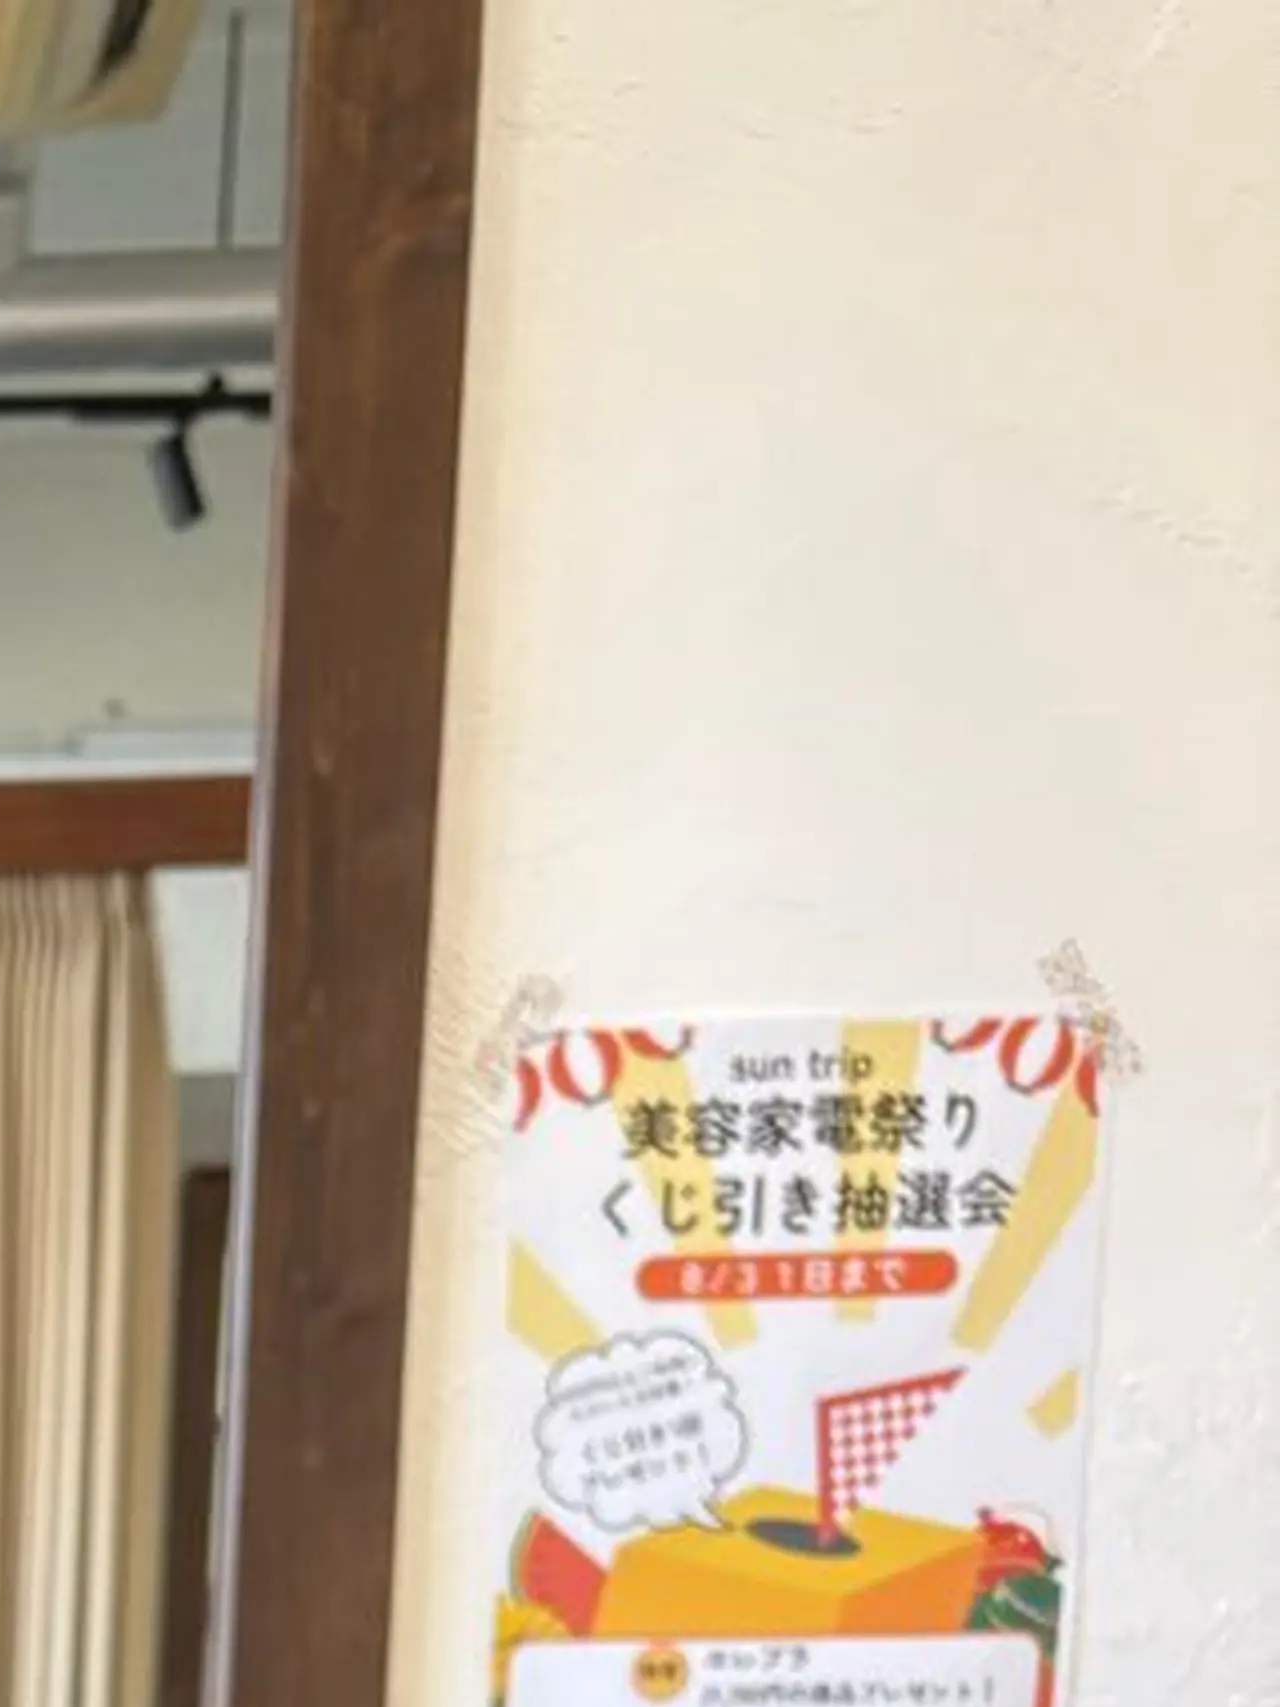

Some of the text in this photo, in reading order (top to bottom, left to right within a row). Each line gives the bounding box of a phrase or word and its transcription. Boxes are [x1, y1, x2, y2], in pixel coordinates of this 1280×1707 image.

[729, 1047, 873, 1083] sun trip
[623, 1088, 978, 1160] 美容家電祭り
[600, 1168, 1018, 1238] くじ引き抽選会
